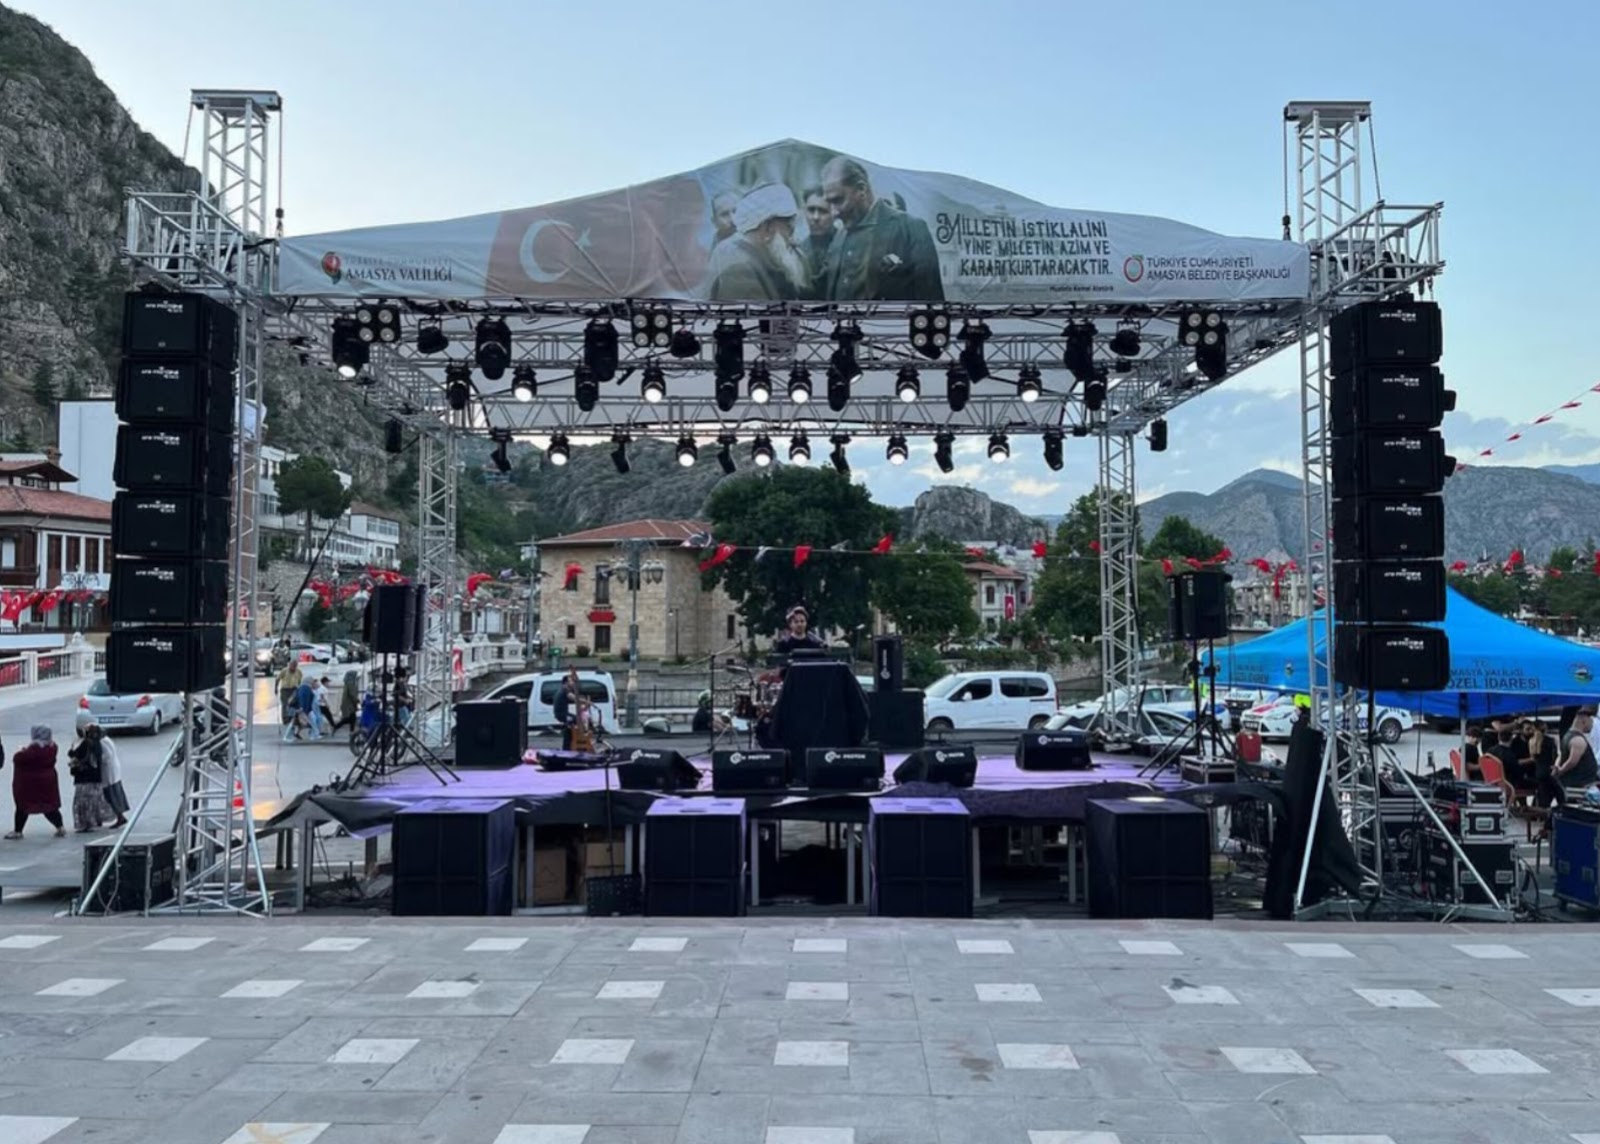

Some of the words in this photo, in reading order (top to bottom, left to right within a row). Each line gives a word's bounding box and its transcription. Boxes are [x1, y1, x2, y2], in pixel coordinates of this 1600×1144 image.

[1094, 240, 1110, 255] VE
[345, 268, 397, 281] AMASYA
[1147, 269, 1186, 281] AMASYA
[1233, 266, 1290, 281] BAŞKANLIĞI
